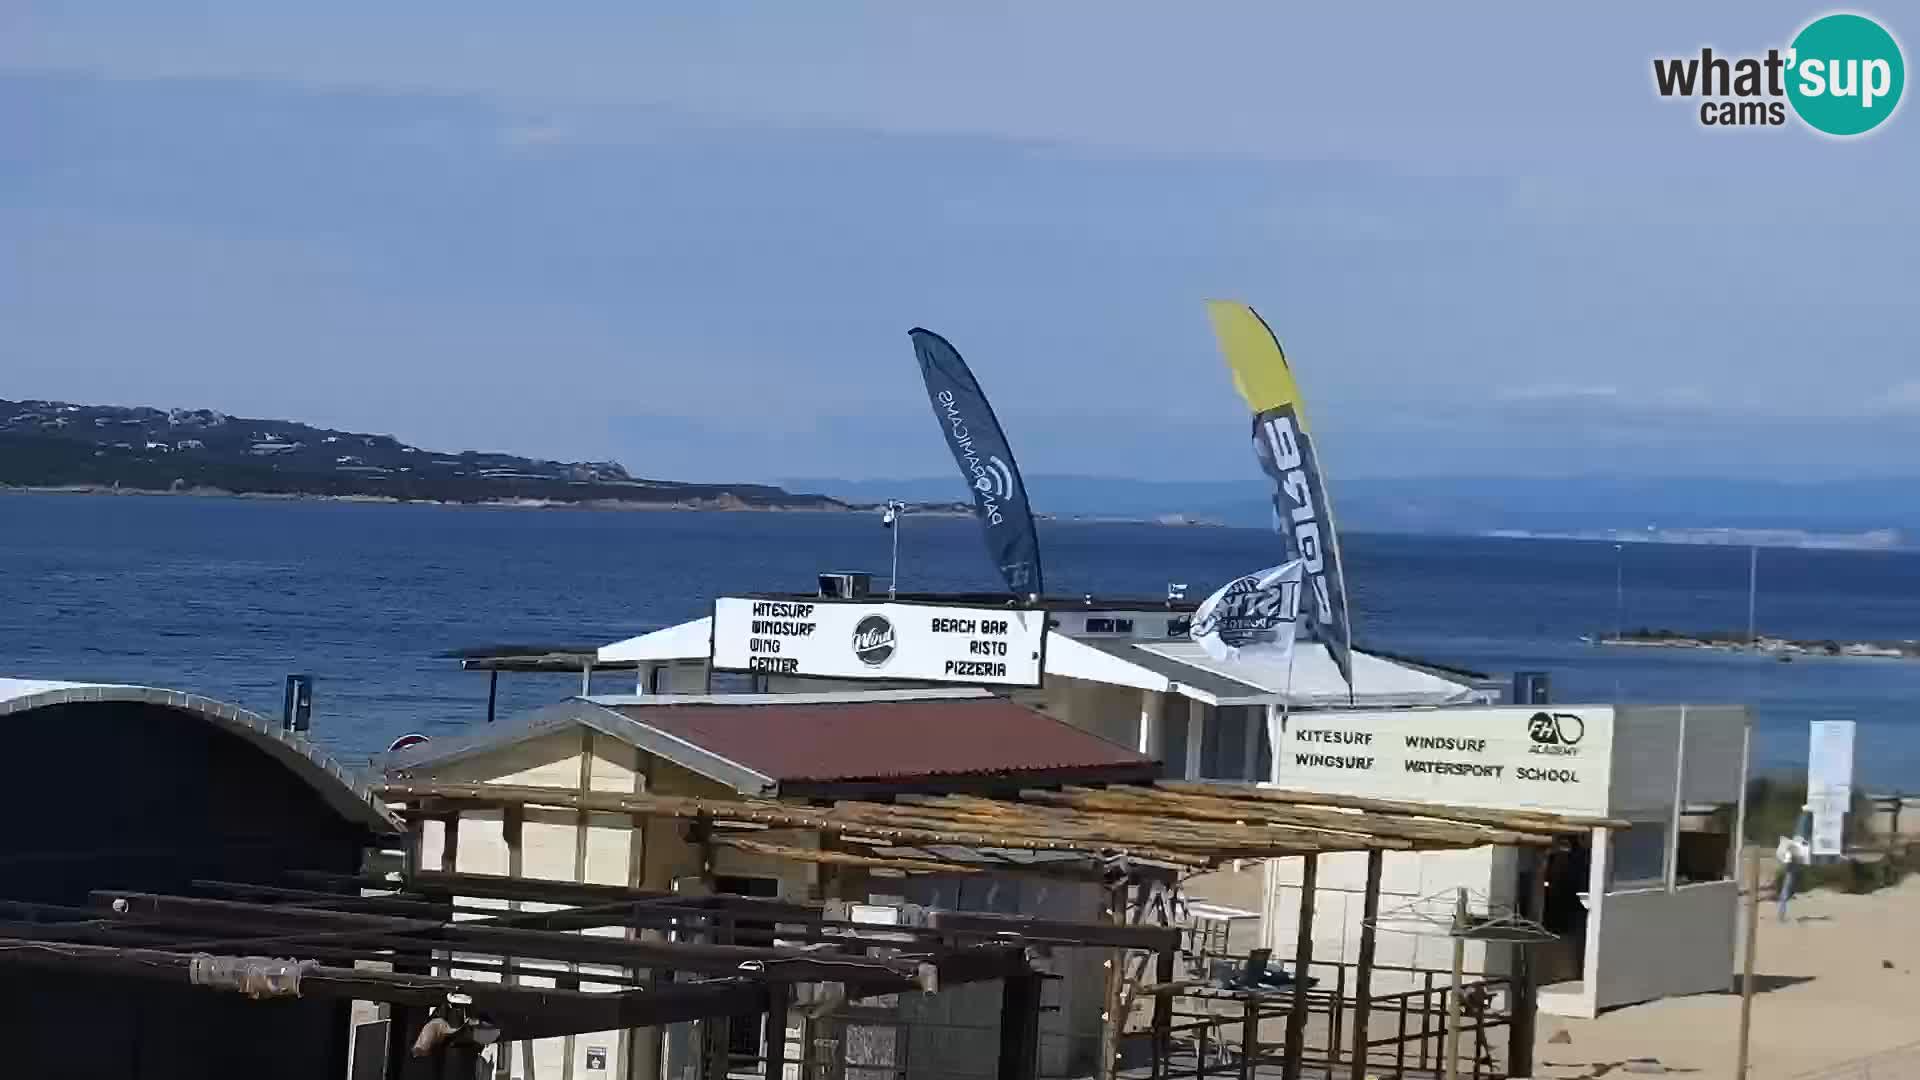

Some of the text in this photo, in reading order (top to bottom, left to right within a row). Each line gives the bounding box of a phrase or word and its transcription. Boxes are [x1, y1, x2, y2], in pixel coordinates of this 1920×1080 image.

[752, 602, 814, 618] KITESURF
[751, 620, 817, 636] WINDSURF
[931, 618, 1009, 635] BEACH BAR
[750, 638, 781, 653] WING
[969, 641, 1008, 656] RISTO
[750, 656, 799, 673] CENTER
[945, 660, 1007, 676] PIZZERIA
[1296, 730, 1373, 746] KITESURF
[1404, 735, 1486, 752] WINDSURF
[1295, 753, 1375, 769] WINGSURF
[1404, 760, 1581, 783] WATERSPORT SCHOOL
